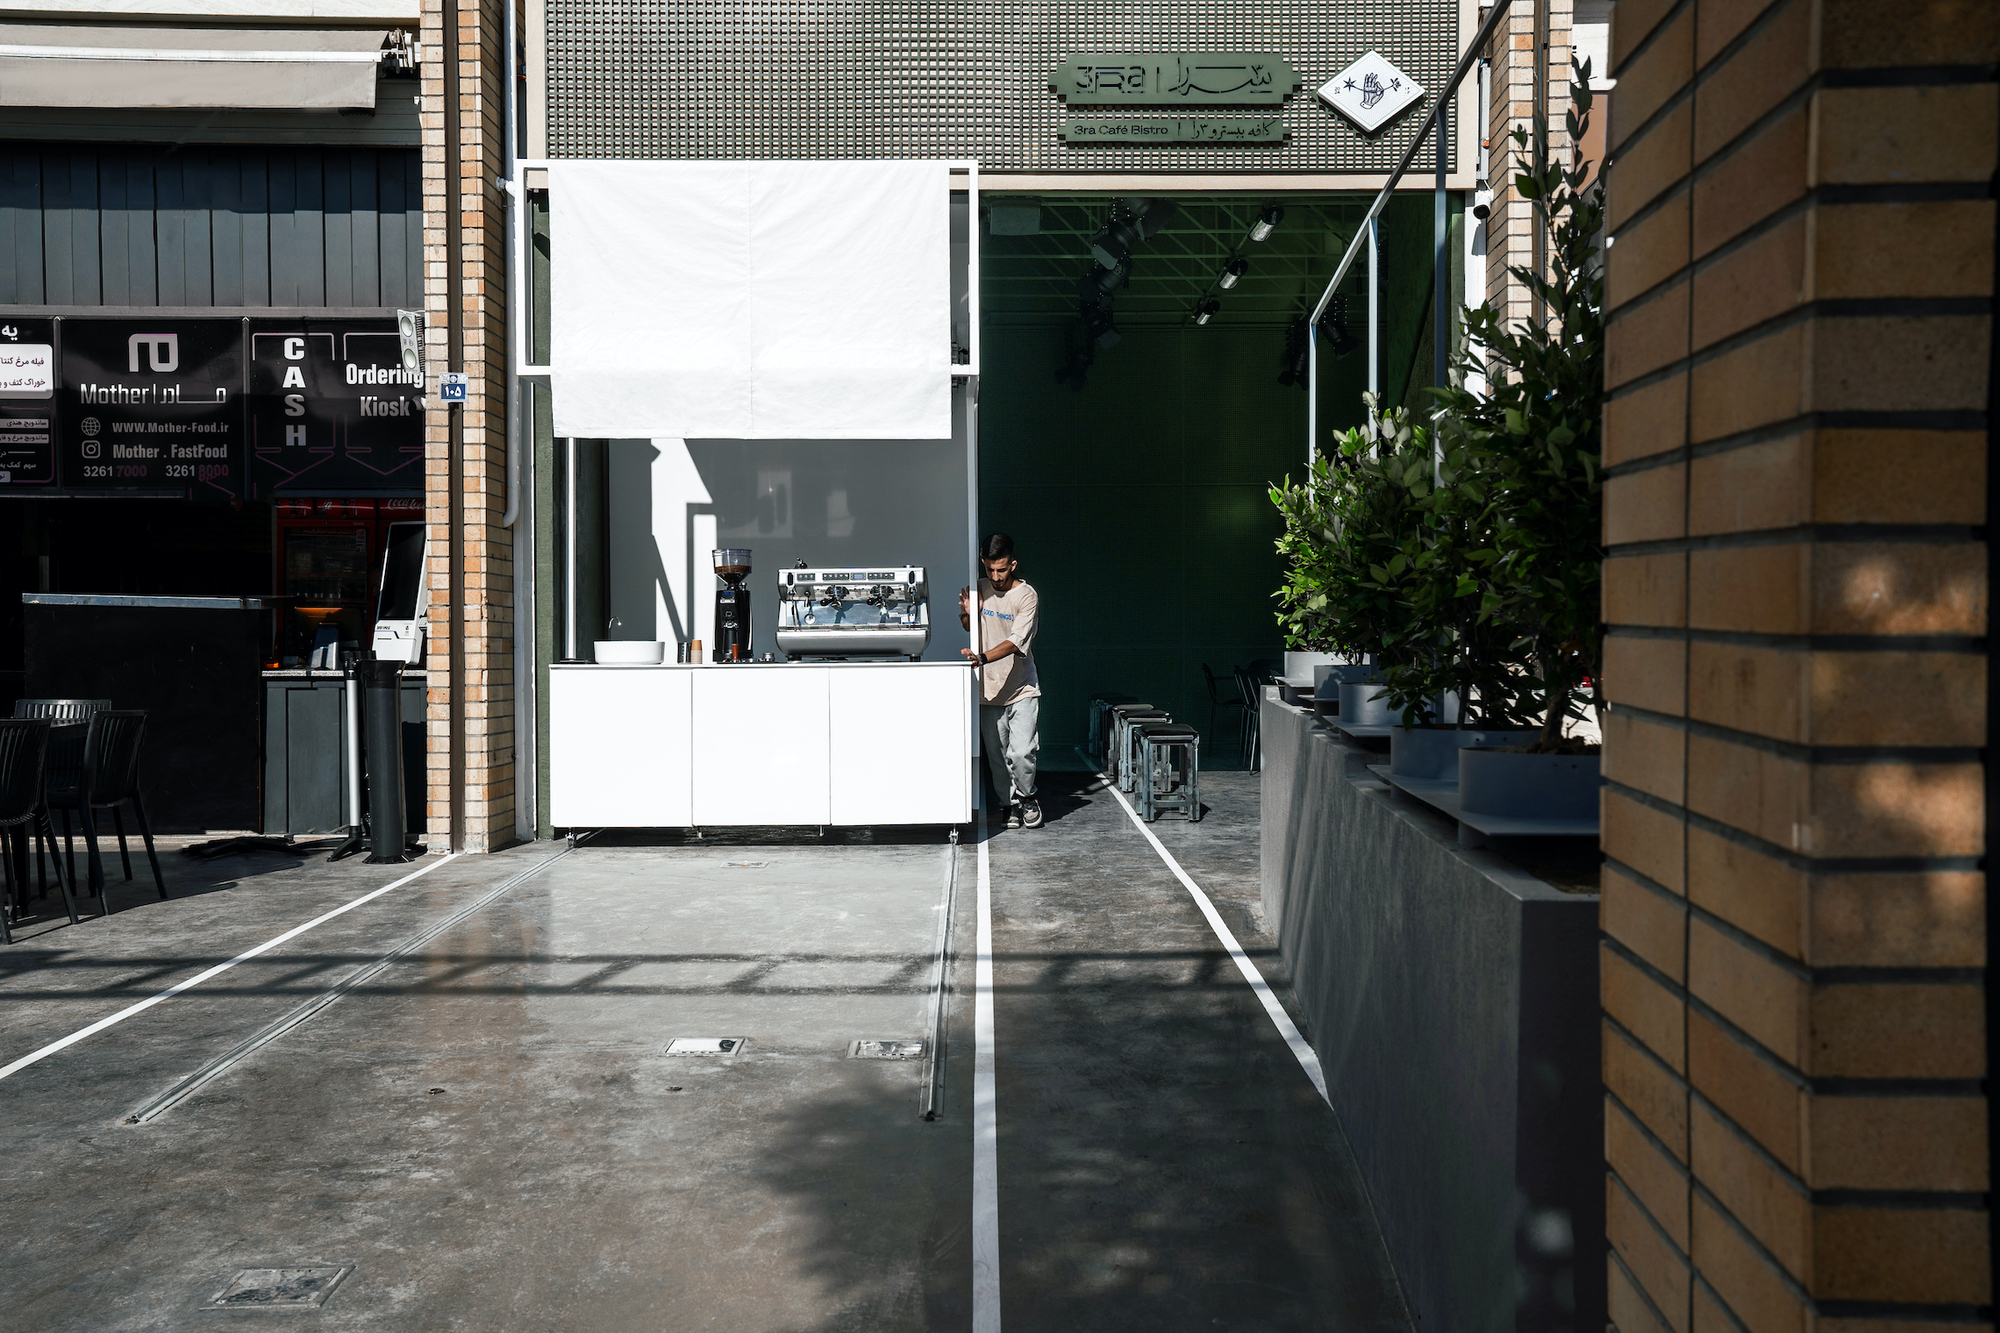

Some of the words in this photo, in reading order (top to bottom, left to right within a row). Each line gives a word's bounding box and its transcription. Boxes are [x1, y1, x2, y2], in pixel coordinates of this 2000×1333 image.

[1074, 124, 1096, 135] 3ra
[1098, 124, 1128, 135] Café
[1130, 124, 1169, 135] Bistro
[1208, 125, 1245, 140] بیسترو
[1247, 120, 1276, 137] کافه
[15, 355, 30, 368] مرغ
[24, 378, 46, 388] خوراک
[346, 363, 424, 389] Ordering
[80, 383, 150, 405] Mother
[445, 385, 462, 397] ۱۰۵
[360, 396, 410, 417] Kiosk
[112, 443, 160, 459] Mother
[171, 443, 228, 459] FastFood
[83, 465, 113, 478] 3261
[165, 464, 195, 477] 3261
